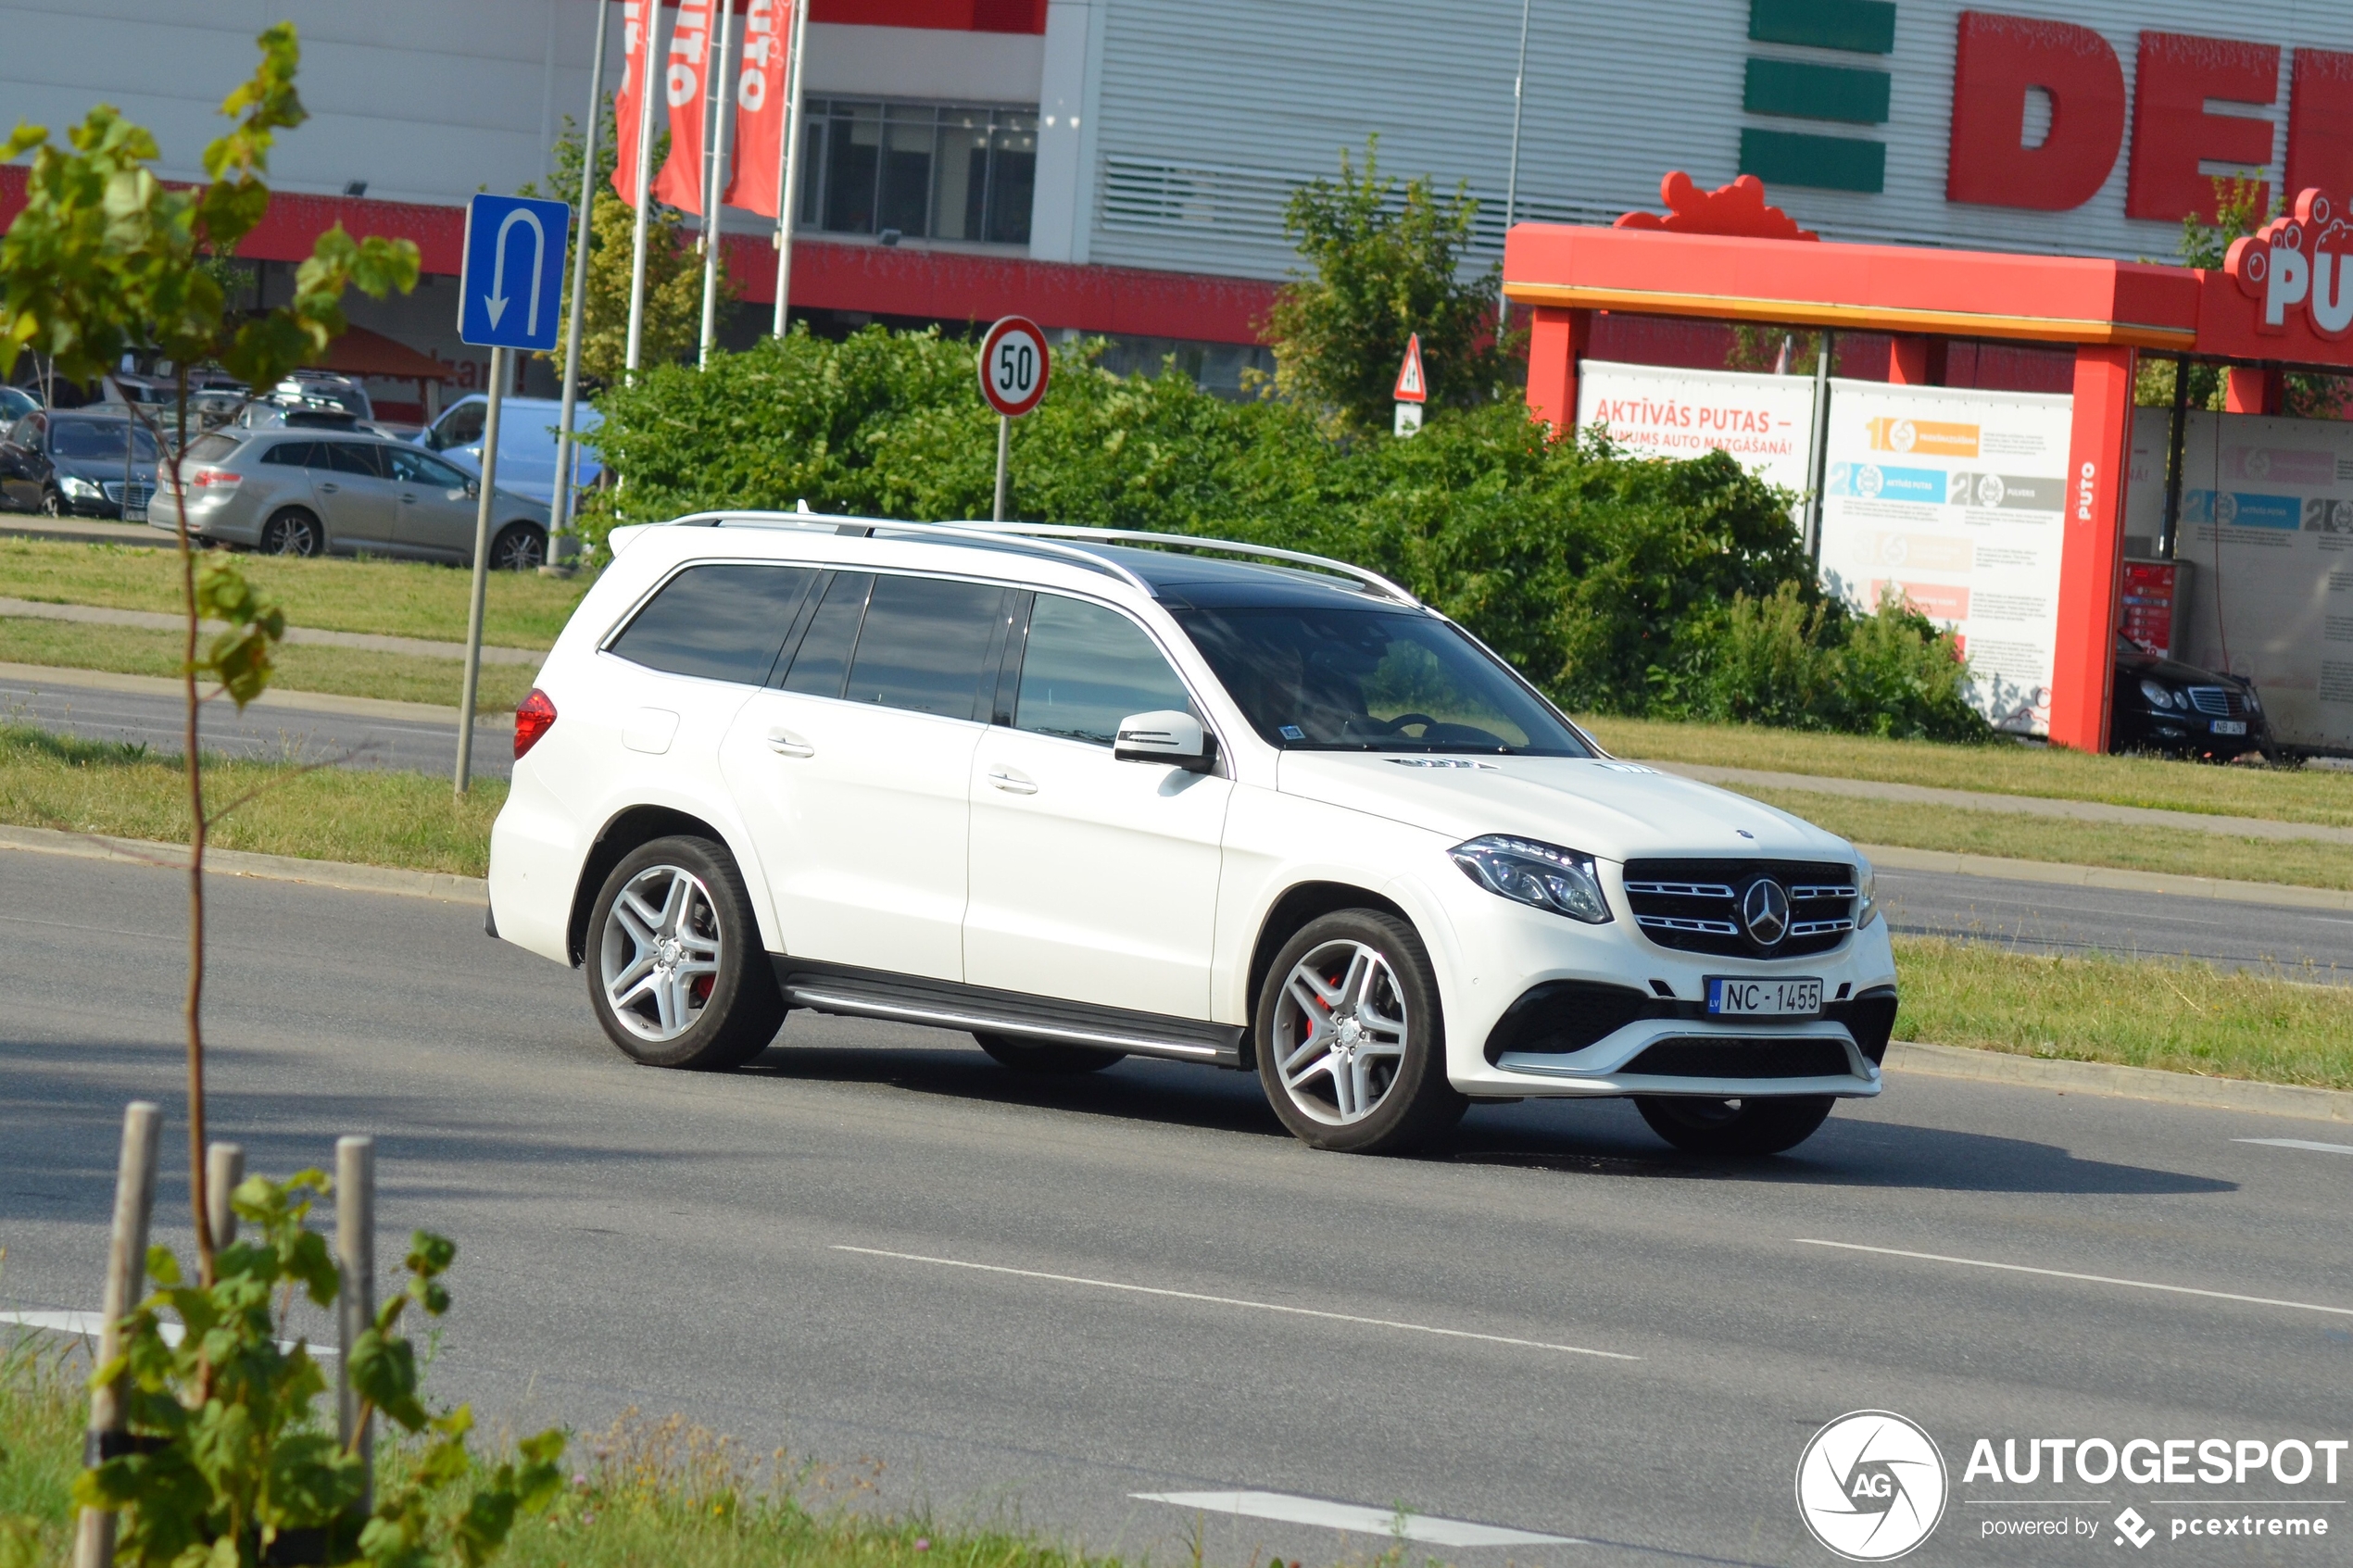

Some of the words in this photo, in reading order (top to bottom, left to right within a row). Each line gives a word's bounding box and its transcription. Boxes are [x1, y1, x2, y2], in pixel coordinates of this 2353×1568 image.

[1000, 345, 1032, 391] 50
[1595, 397, 1691, 428] AKTĪVĀS
[1699, 407, 1769, 433] PUTAS
[1663, 433, 1700, 449] AUTO
[1704, 438, 1793, 456] MAZGĀŠANĀ!
[2078, 462, 2095, 521] PUTO
[1709, 999, 1720, 1008] LV
